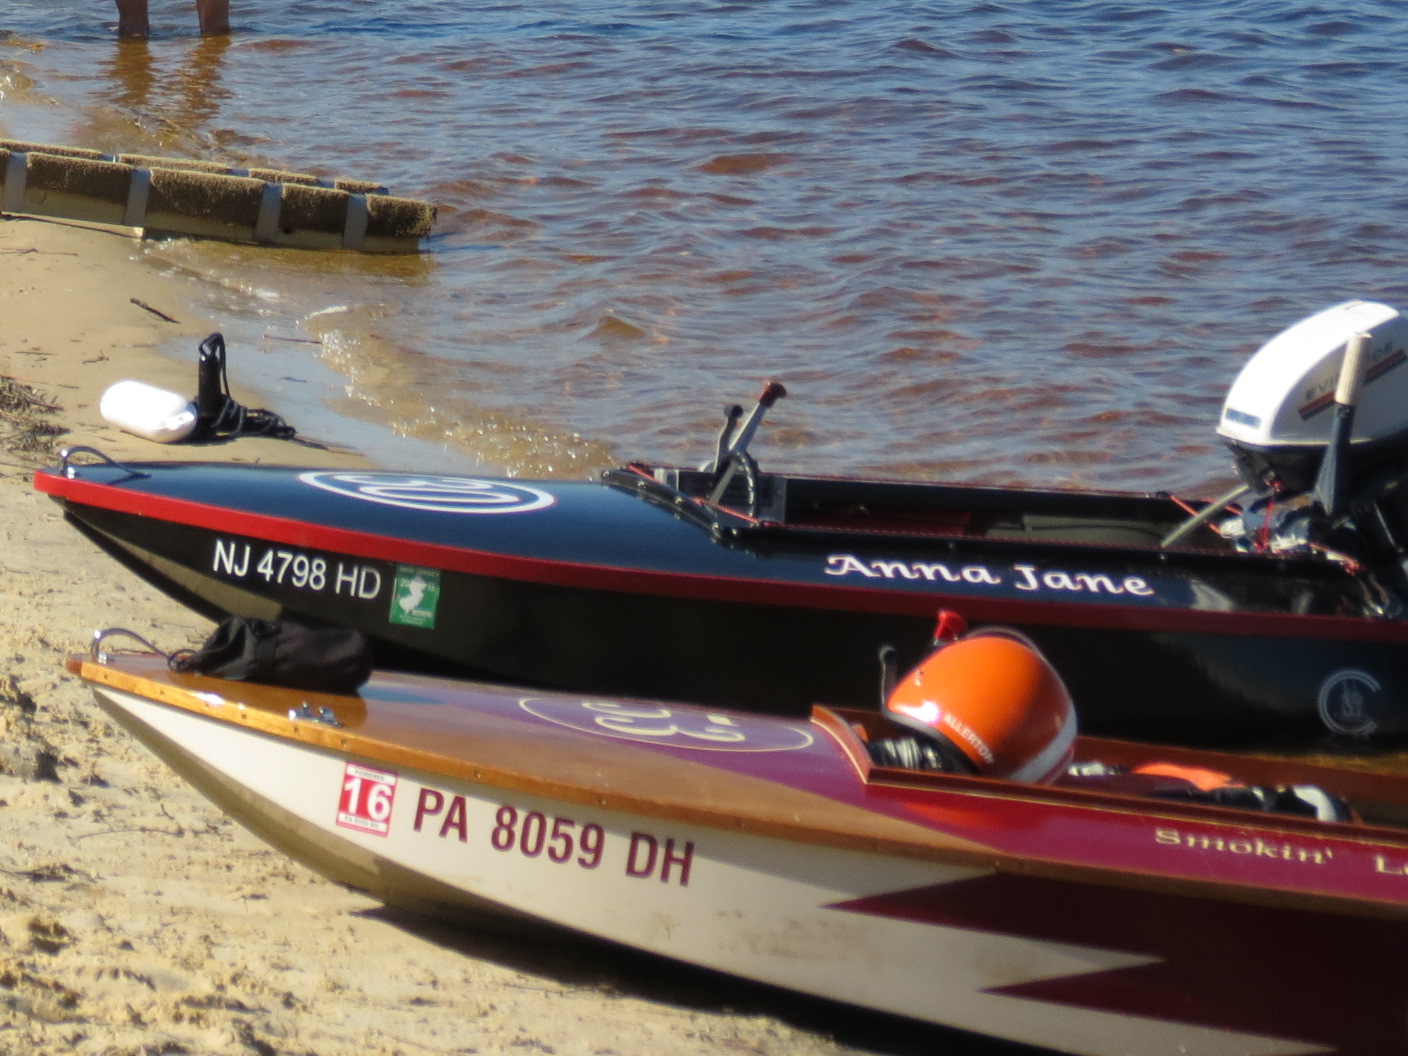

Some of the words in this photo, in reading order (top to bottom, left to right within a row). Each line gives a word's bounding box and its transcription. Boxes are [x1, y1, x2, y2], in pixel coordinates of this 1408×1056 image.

[212, 539, 251, 577] NJ
[256, 548, 327, 591] 4798
[335, 562, 382, 600] HD
[824, 553, 1001, 585] Anna
[1013, 562, 1155, 596] Jane
[344, 777, 393, 823] 16
[413, 787, 468, 844] PA
[491, 805, 606, 870] 8059
[625, 831, 695, 887] DH
[1154, 827, 1334, 865] Smokin'
